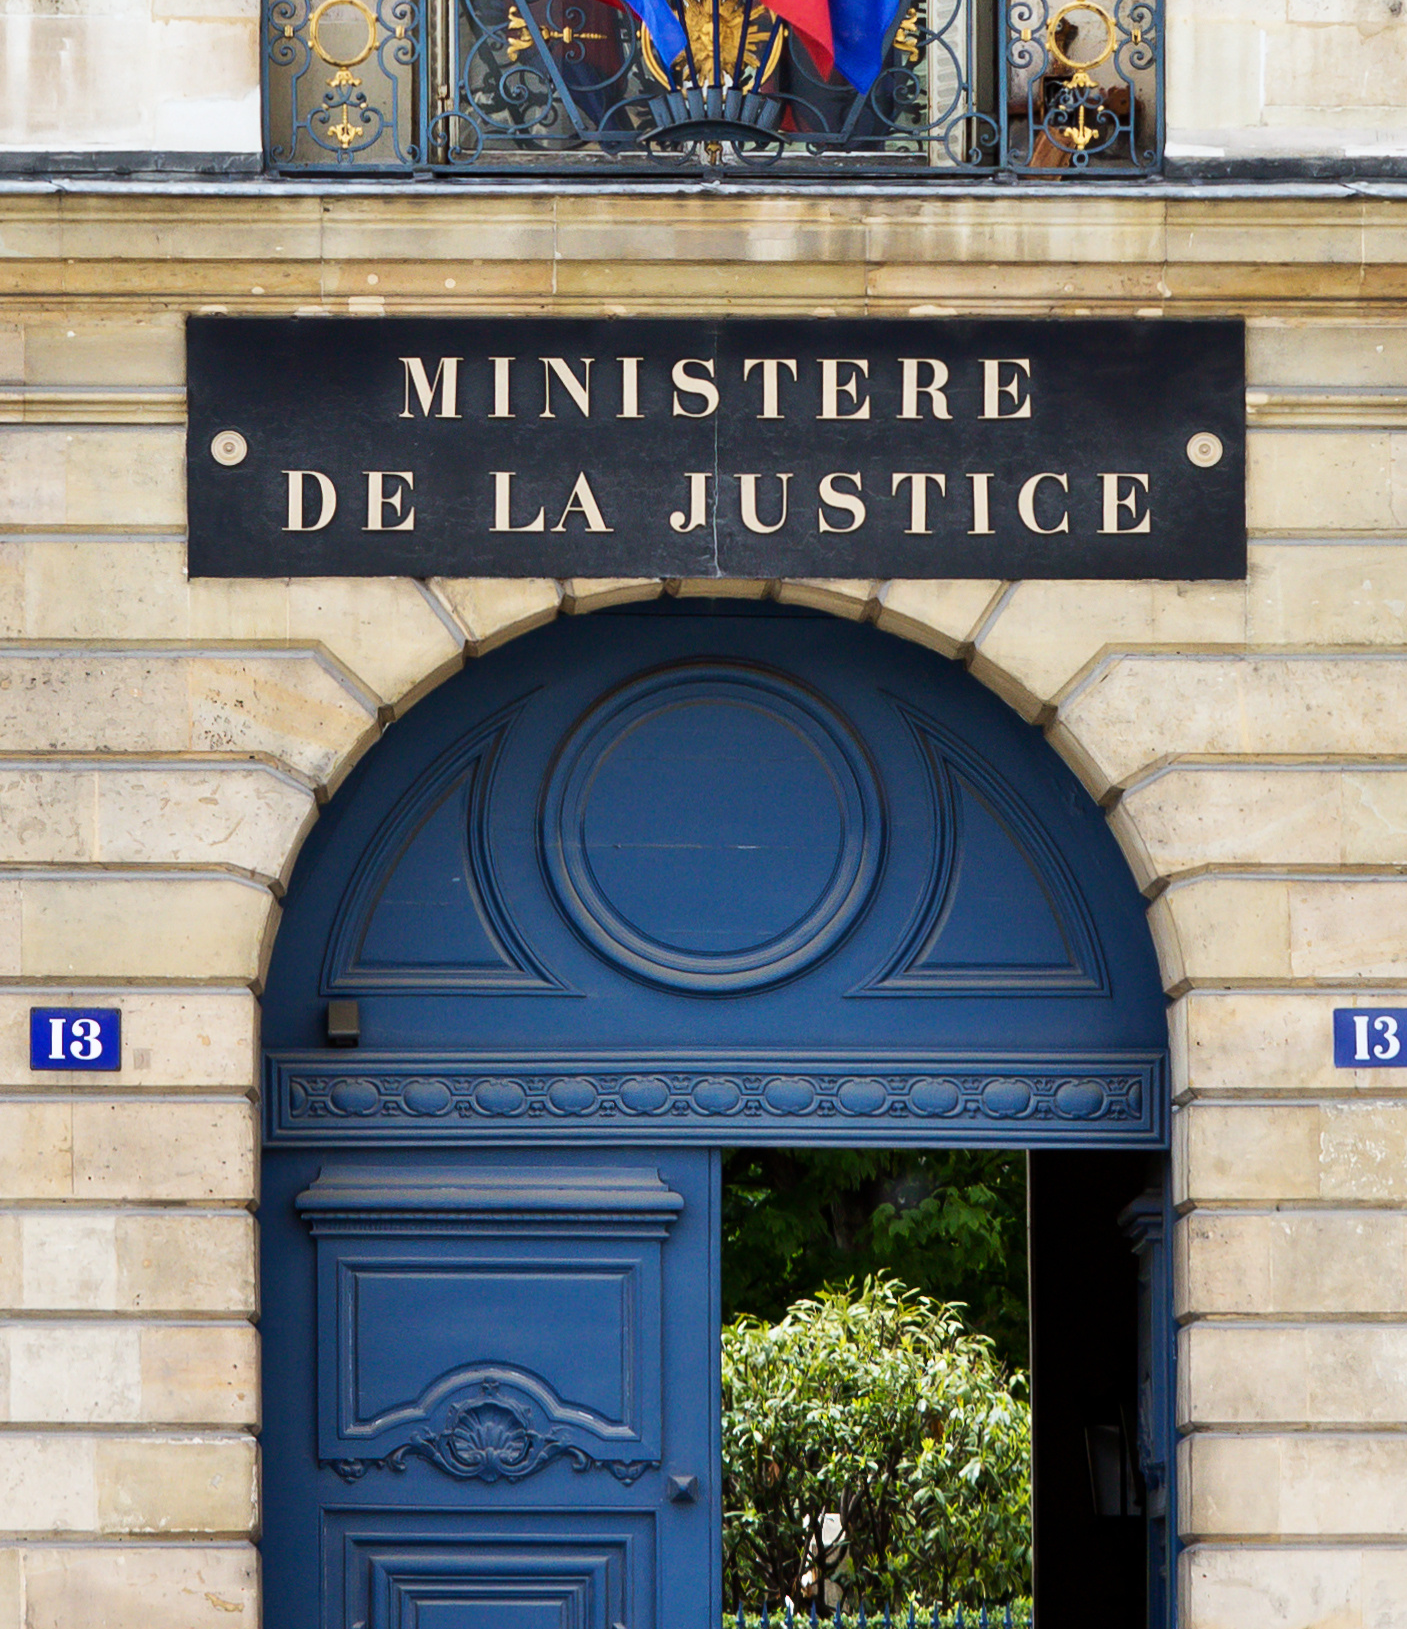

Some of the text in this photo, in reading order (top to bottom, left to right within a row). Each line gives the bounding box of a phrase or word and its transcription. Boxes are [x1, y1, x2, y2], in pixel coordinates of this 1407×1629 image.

[398, 357, 1032, 420] MINISTERE
[280, 470, 1151, 535] DE LA JUSTICE
[48, 1018, 103, 1061] 13
[1352, 1015, 1401, 1061] 13
